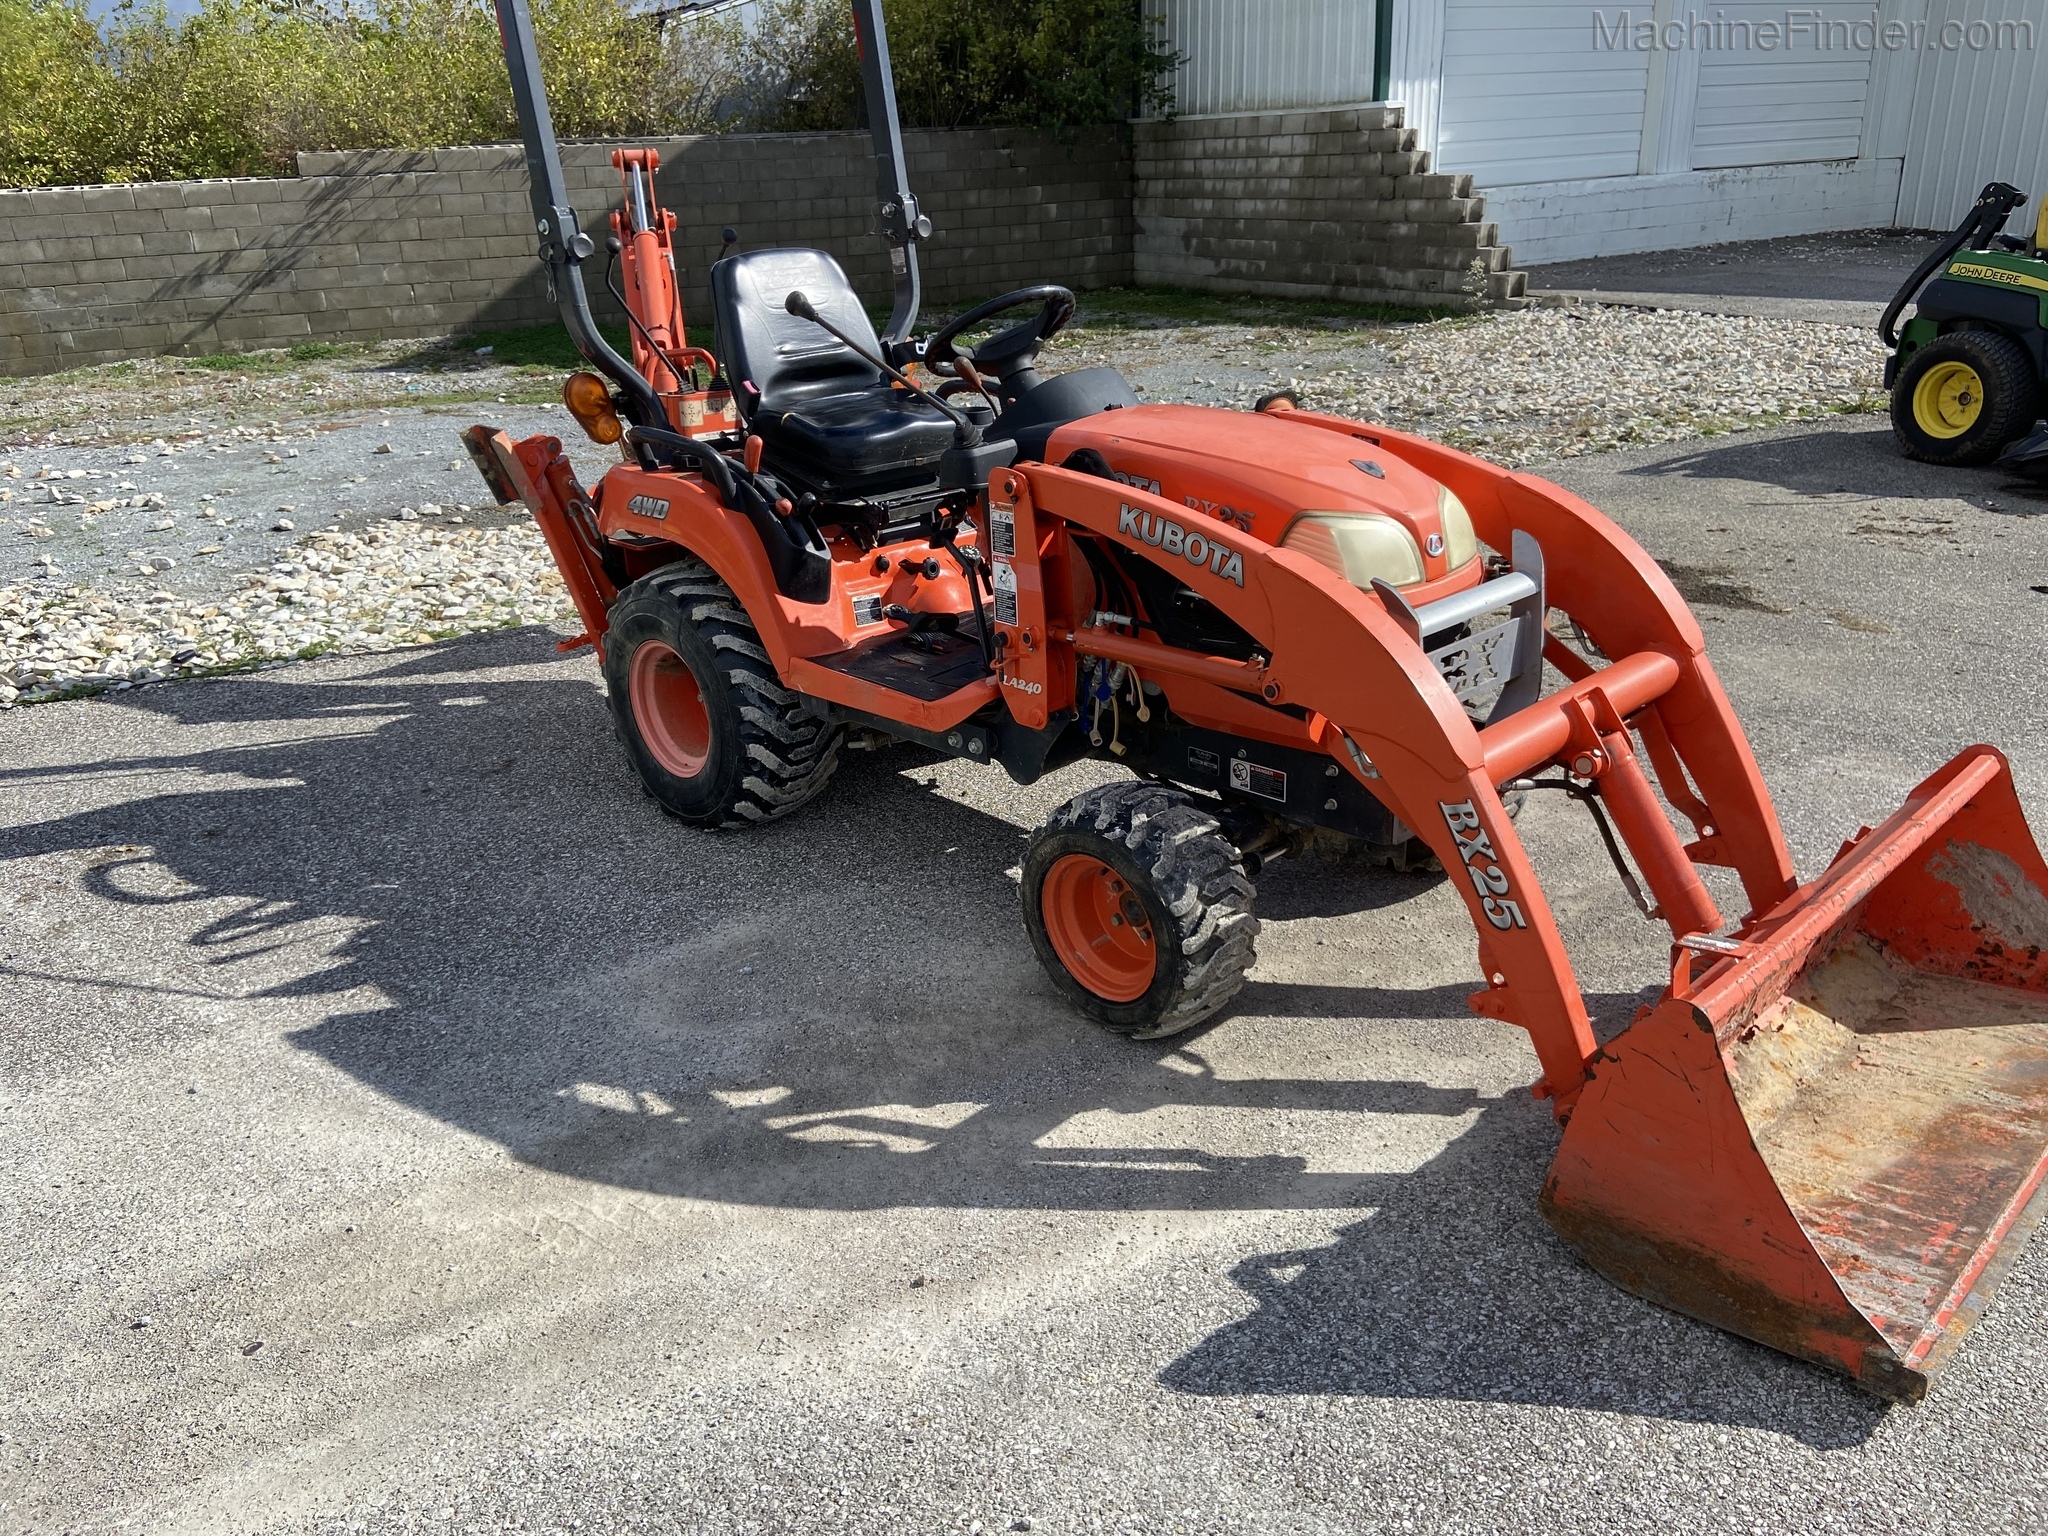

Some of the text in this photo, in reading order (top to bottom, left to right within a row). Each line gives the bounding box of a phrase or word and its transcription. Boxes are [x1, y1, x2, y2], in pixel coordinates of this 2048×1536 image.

[1953, 265, 2022, 284] JOHN DEERE
[627, 495, 670, 519] 4WD
[1118, 503, 1244, 588] KUBOTA
[1003, 674, 1042, 695] LA240
[1438, 799, 1528, 931] BX25
